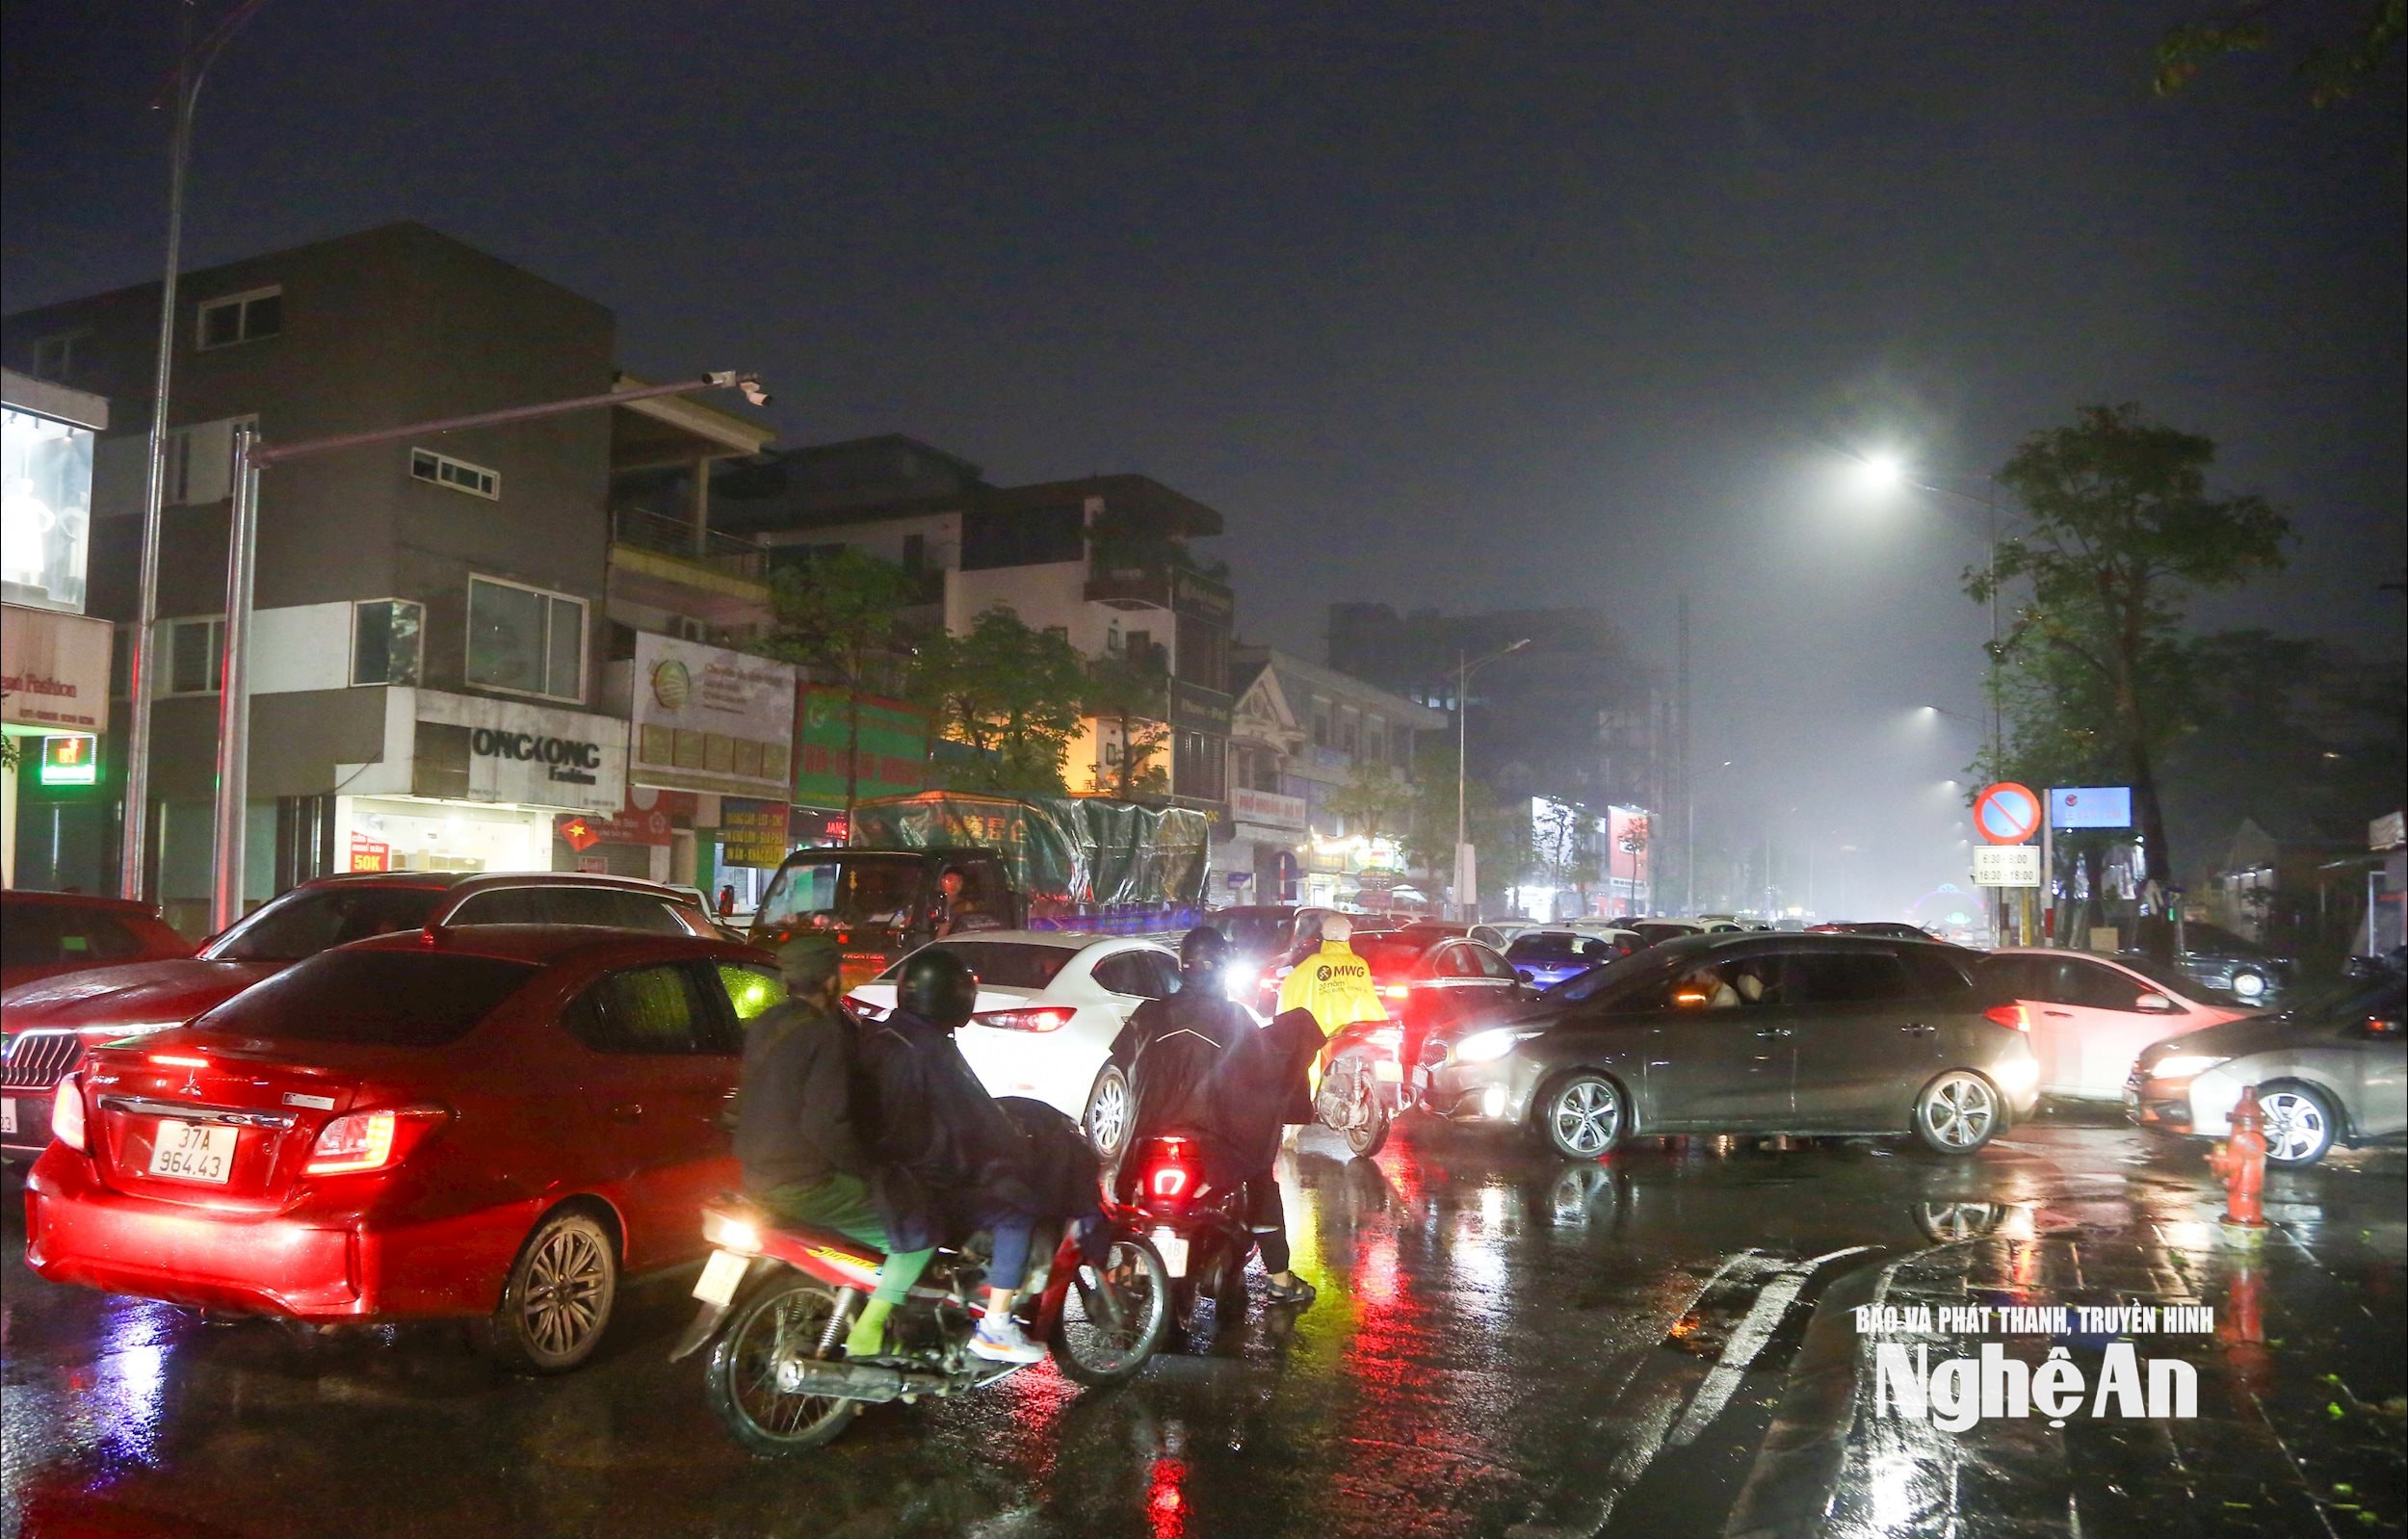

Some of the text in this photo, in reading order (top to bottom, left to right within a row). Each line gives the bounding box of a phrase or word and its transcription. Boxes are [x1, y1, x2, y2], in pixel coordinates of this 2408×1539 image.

[353, 853, 380, 872] 50K
[1979, 871, 2002, 880] 16:30
[1334, 965, 1365, 978] MWG
[178, 1128, 210, 1151] 37A
[159, 1151, 221, 1178] 964.43
